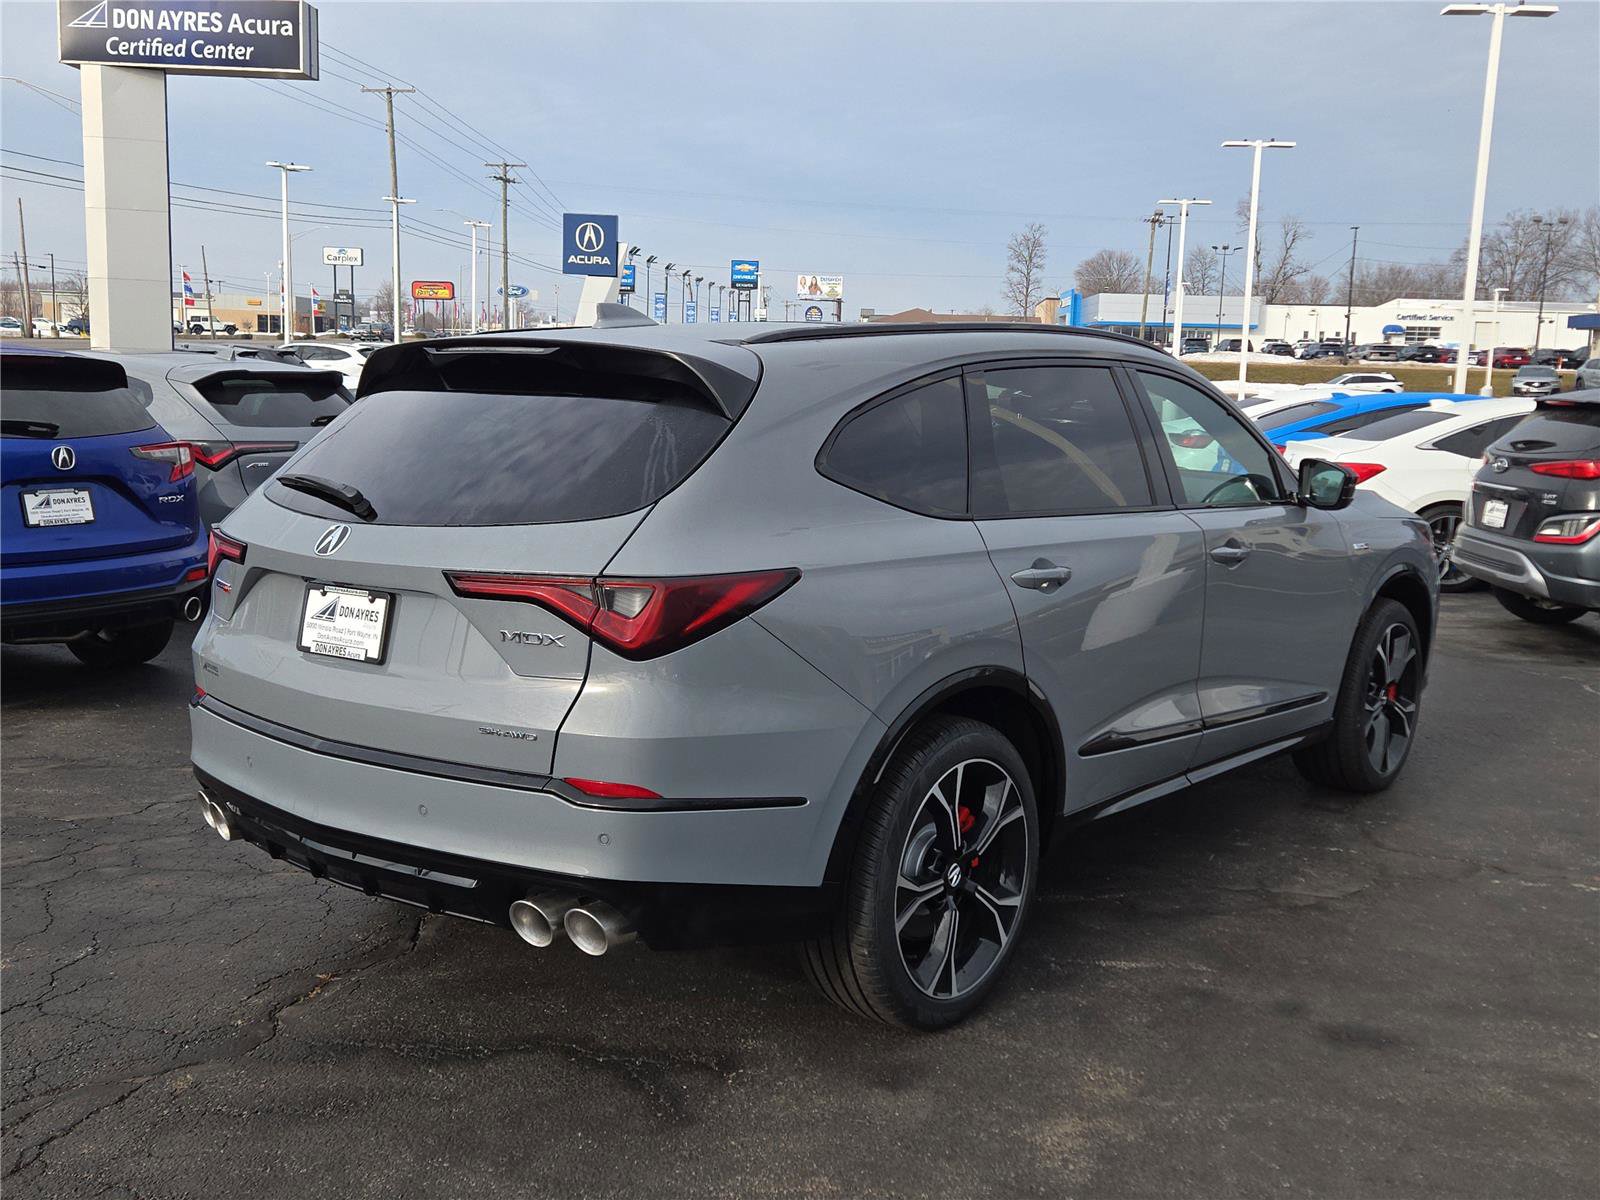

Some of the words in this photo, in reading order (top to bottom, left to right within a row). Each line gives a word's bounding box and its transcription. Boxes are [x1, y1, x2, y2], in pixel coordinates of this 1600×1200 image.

[113, 8, 154, 29] DON
[157, 10, 223, 33] AYRES
[227, 13, 293, 36] Acura
[105, 36, 187, 58] Certified
[191, 40, 254, 60] Center
[327, 254, 359, 264] Carplex
[568, 255, 611, 265] ACURA
[67, 496, 86, 504] AYRES
[158, 494, 185, 504] RDX
[339, 605, 355, 619] DON
[355, 608, 380, 623] AYRES
[500, 630, 566, 648] MDX
[315, 643, 329, 654] DON
[328, 645, 347, 656] AYRES
[347, 651, 361, 659] Acura
